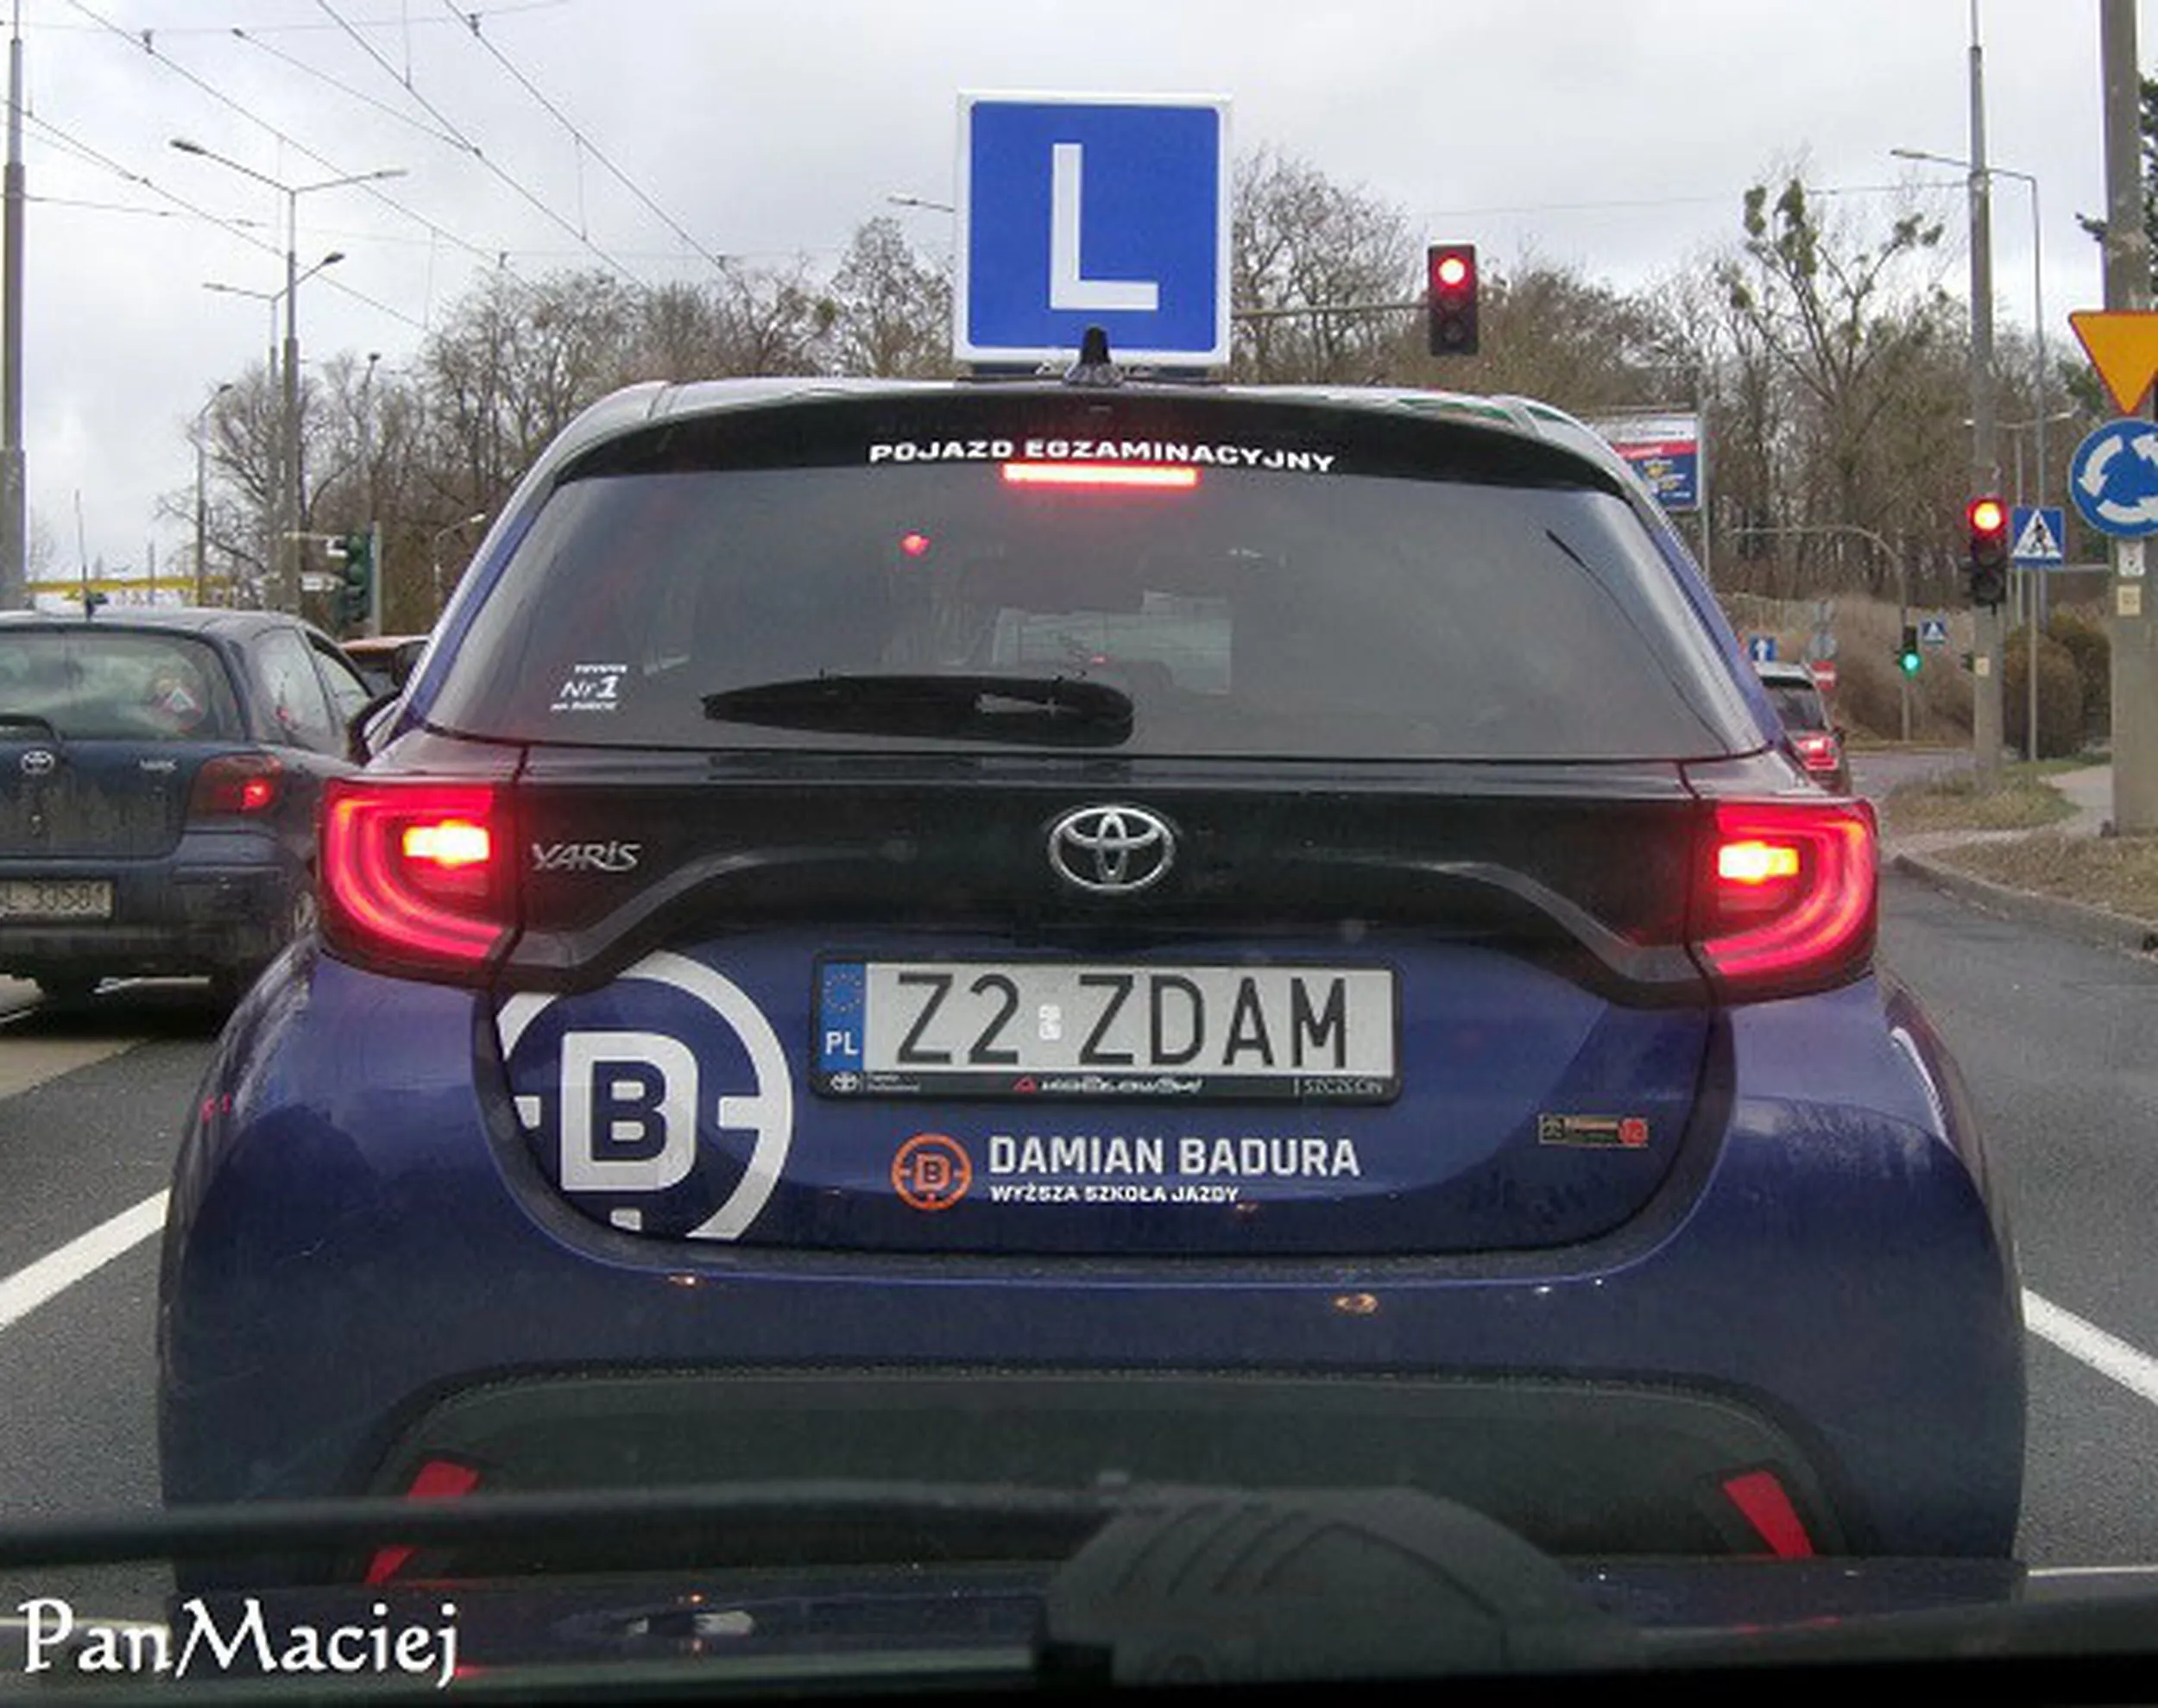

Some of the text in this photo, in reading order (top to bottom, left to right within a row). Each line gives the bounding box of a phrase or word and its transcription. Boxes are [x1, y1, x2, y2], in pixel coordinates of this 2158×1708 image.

[1049, 142, 1158, 311] L
[869, 438, 1335, 472] POJAZD EGZAMINACYJNY
[532, 840, 640, 872] YARIS
[897, 972, 1346, 1068] Z2 ZDAM
[825, 1030, 859, 1056] PL
[988, 1135, 1361, 1177] DAMIAN BADURA
[990, 1182, 1240, 1202] WYŻSZA SZKOŁA JAZDY
